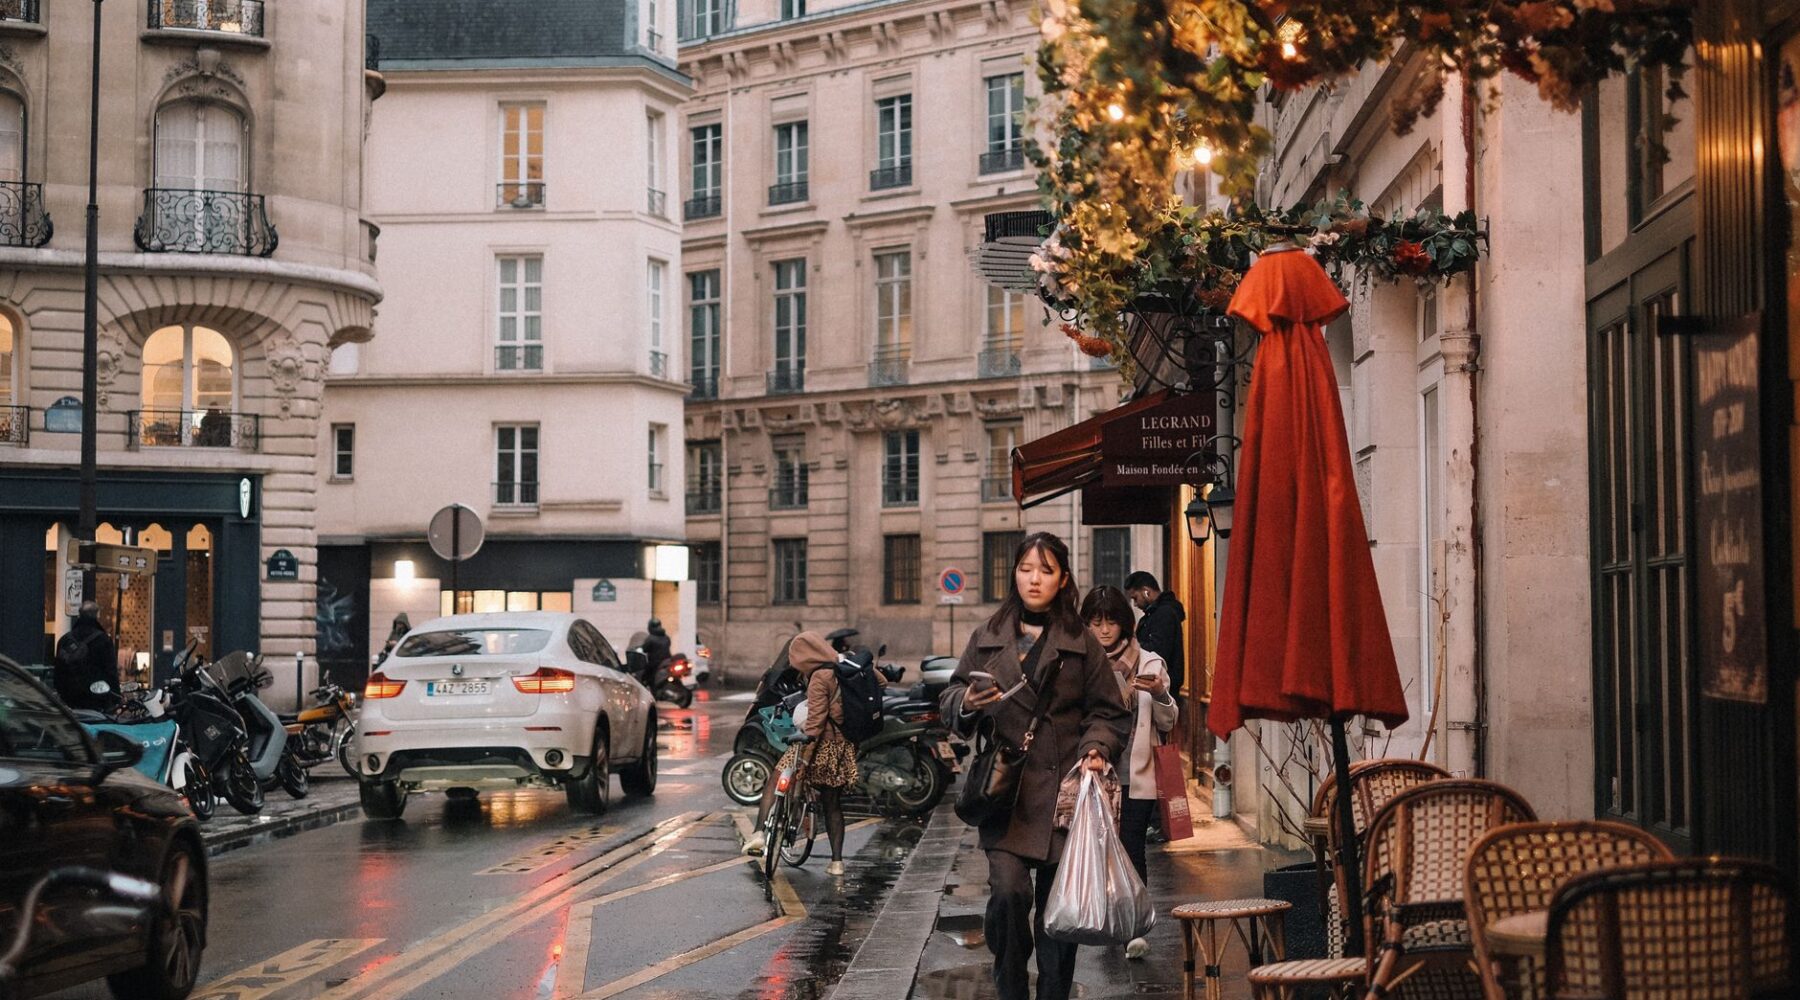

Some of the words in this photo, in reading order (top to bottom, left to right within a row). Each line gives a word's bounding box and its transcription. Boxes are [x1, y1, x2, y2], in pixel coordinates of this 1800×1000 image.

[1142, 415, 1211, 429] LEGRAND
[1142, 436, 1172, 449] Filles
[1176, 439, 1187, 448] et
[1117, 464, 1149, 475] Maison
[1152, 464, 1184, 474] Fondée
[436, 683, 454, 694] 4AZ
[462, 682, 487, 694] 2855
